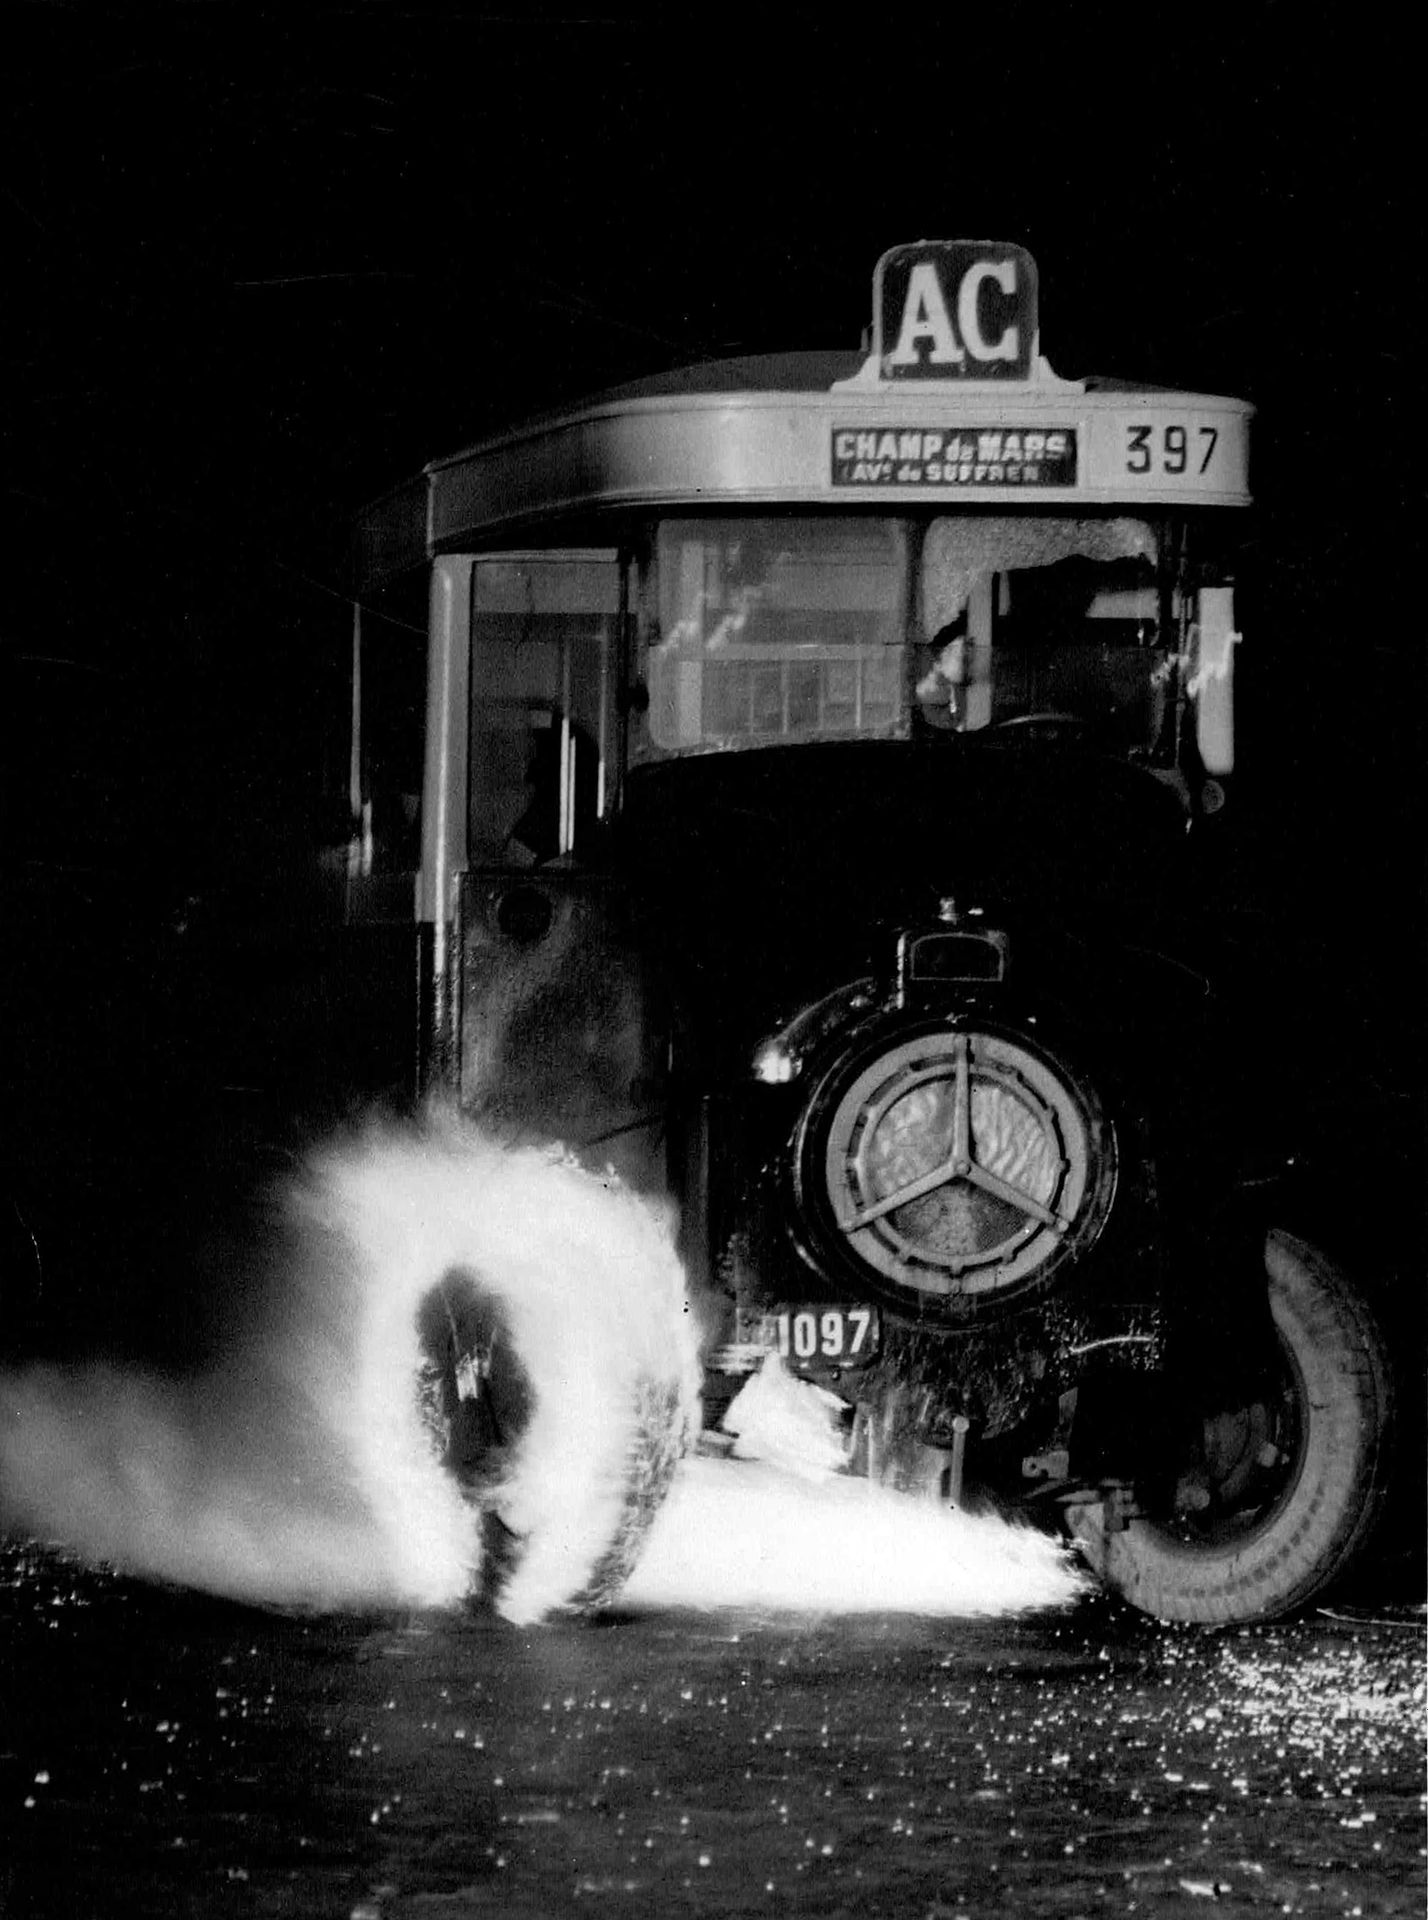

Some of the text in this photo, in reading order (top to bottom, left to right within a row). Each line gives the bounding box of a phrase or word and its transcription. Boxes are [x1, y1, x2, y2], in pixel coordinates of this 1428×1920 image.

[889, 260, 1020, 364] AC
[835, 431, 1067, 461] CHAMP de MARS
[1125, 425, 1220, 475] 397
[777, 1309, 871, 1358] 1097
